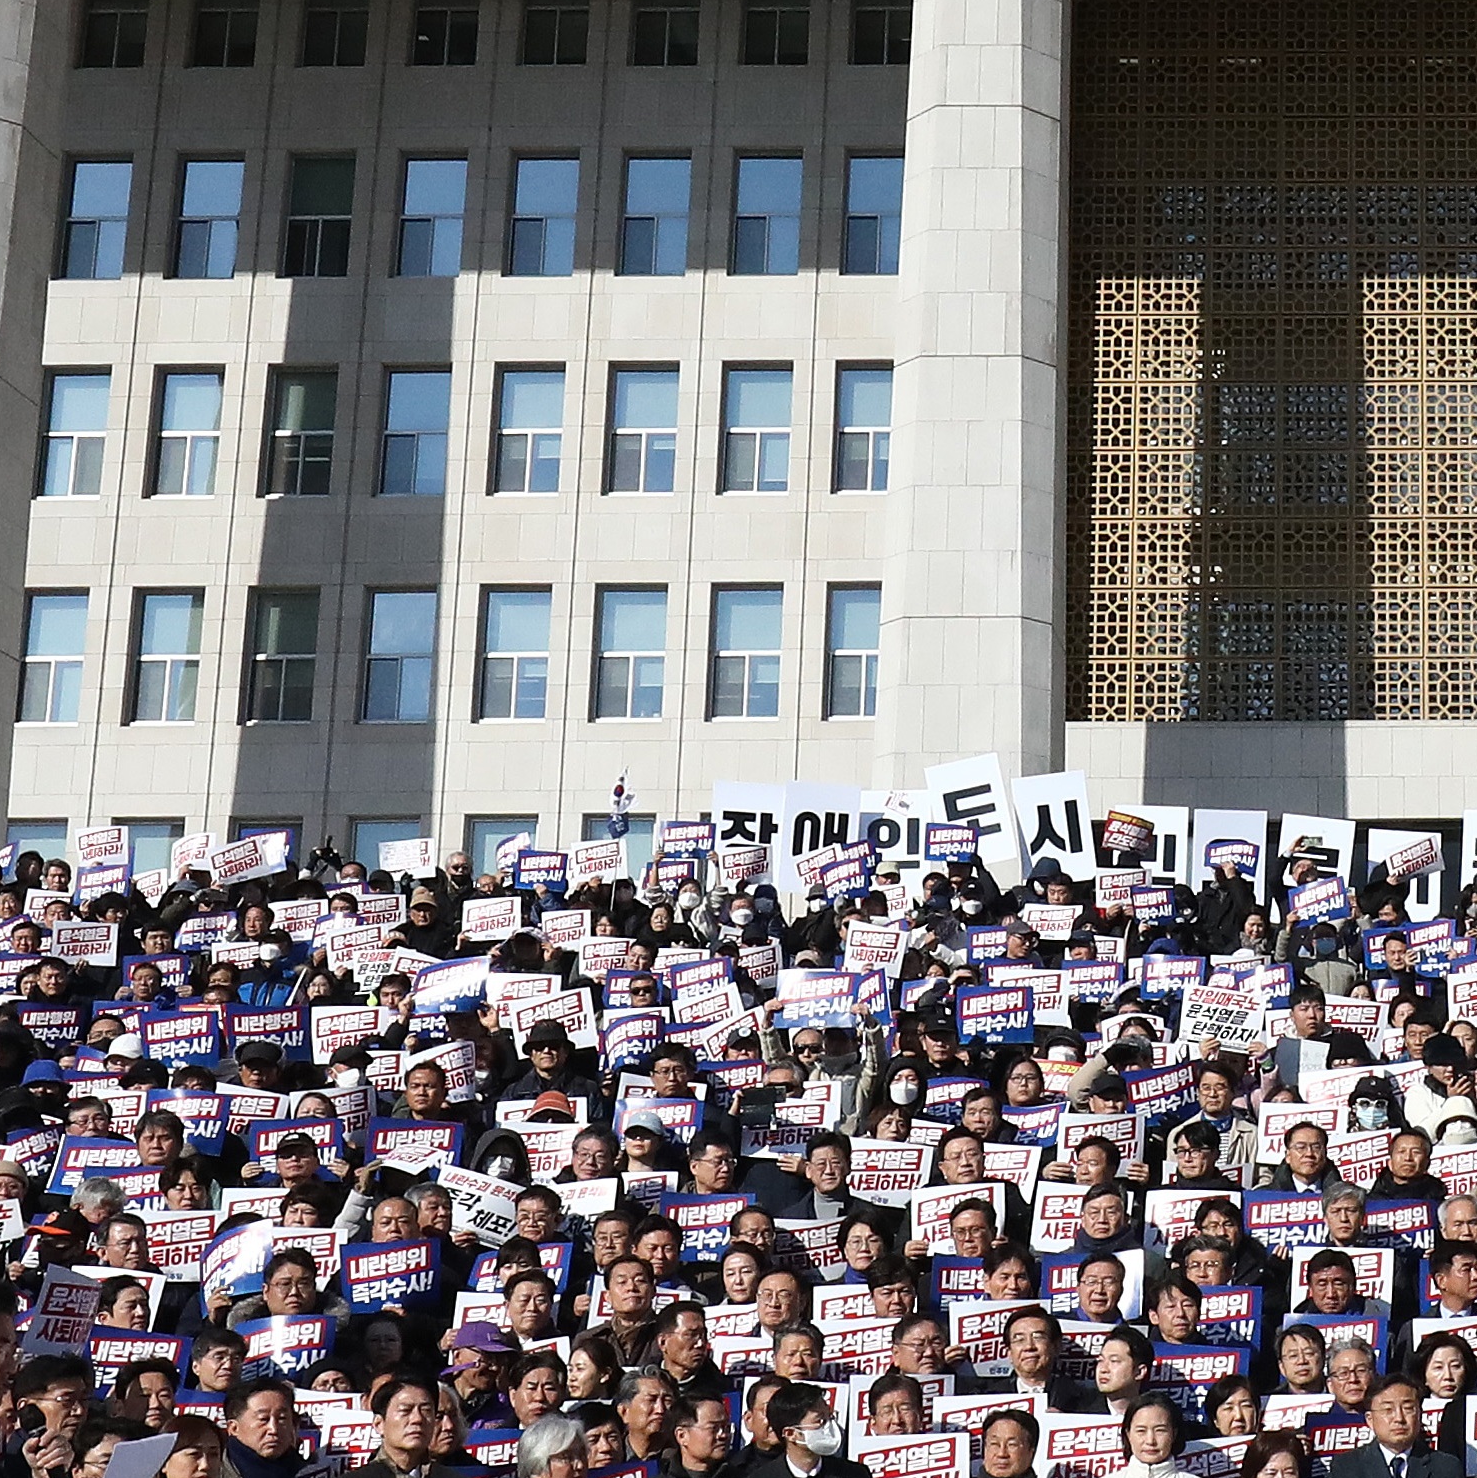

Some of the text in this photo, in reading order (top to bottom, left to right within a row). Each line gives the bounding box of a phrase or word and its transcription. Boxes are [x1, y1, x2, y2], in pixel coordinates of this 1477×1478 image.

[57, 926, 114, 942] 윤석열은
[60, 940, 112, 957] 사퇴하라!
[962, 993, 1028, 1021] 내란행위
[1189, 988, 1260, 1010] 친일매국노
[232, 1011, 303, 1032] 내란행위
[963, 1012, 1028, 1036] 즉각수사!
[1186, 1004, 1249, 1025] 윤석열을
[147, 1016, 215, 1040] 내란행위
[1192, 1021, 1259, 1042] 탄핵하자!
[149, 1036, 213, 1062] 즉각수사!
[851, 1147, 923, 1171] 윤석열은
[848, 1168, 922, 1191] 사퇴하라!
[468, 1209, 515, 1237] 체포!
[348, 1250, 427, 1281] 내란행위
[351, 1272, 432, 1302] 즉각수사!
[91, 1340, 179, 1368] 내란행위
[860, 1441, 951, 1478] 윤석열은
